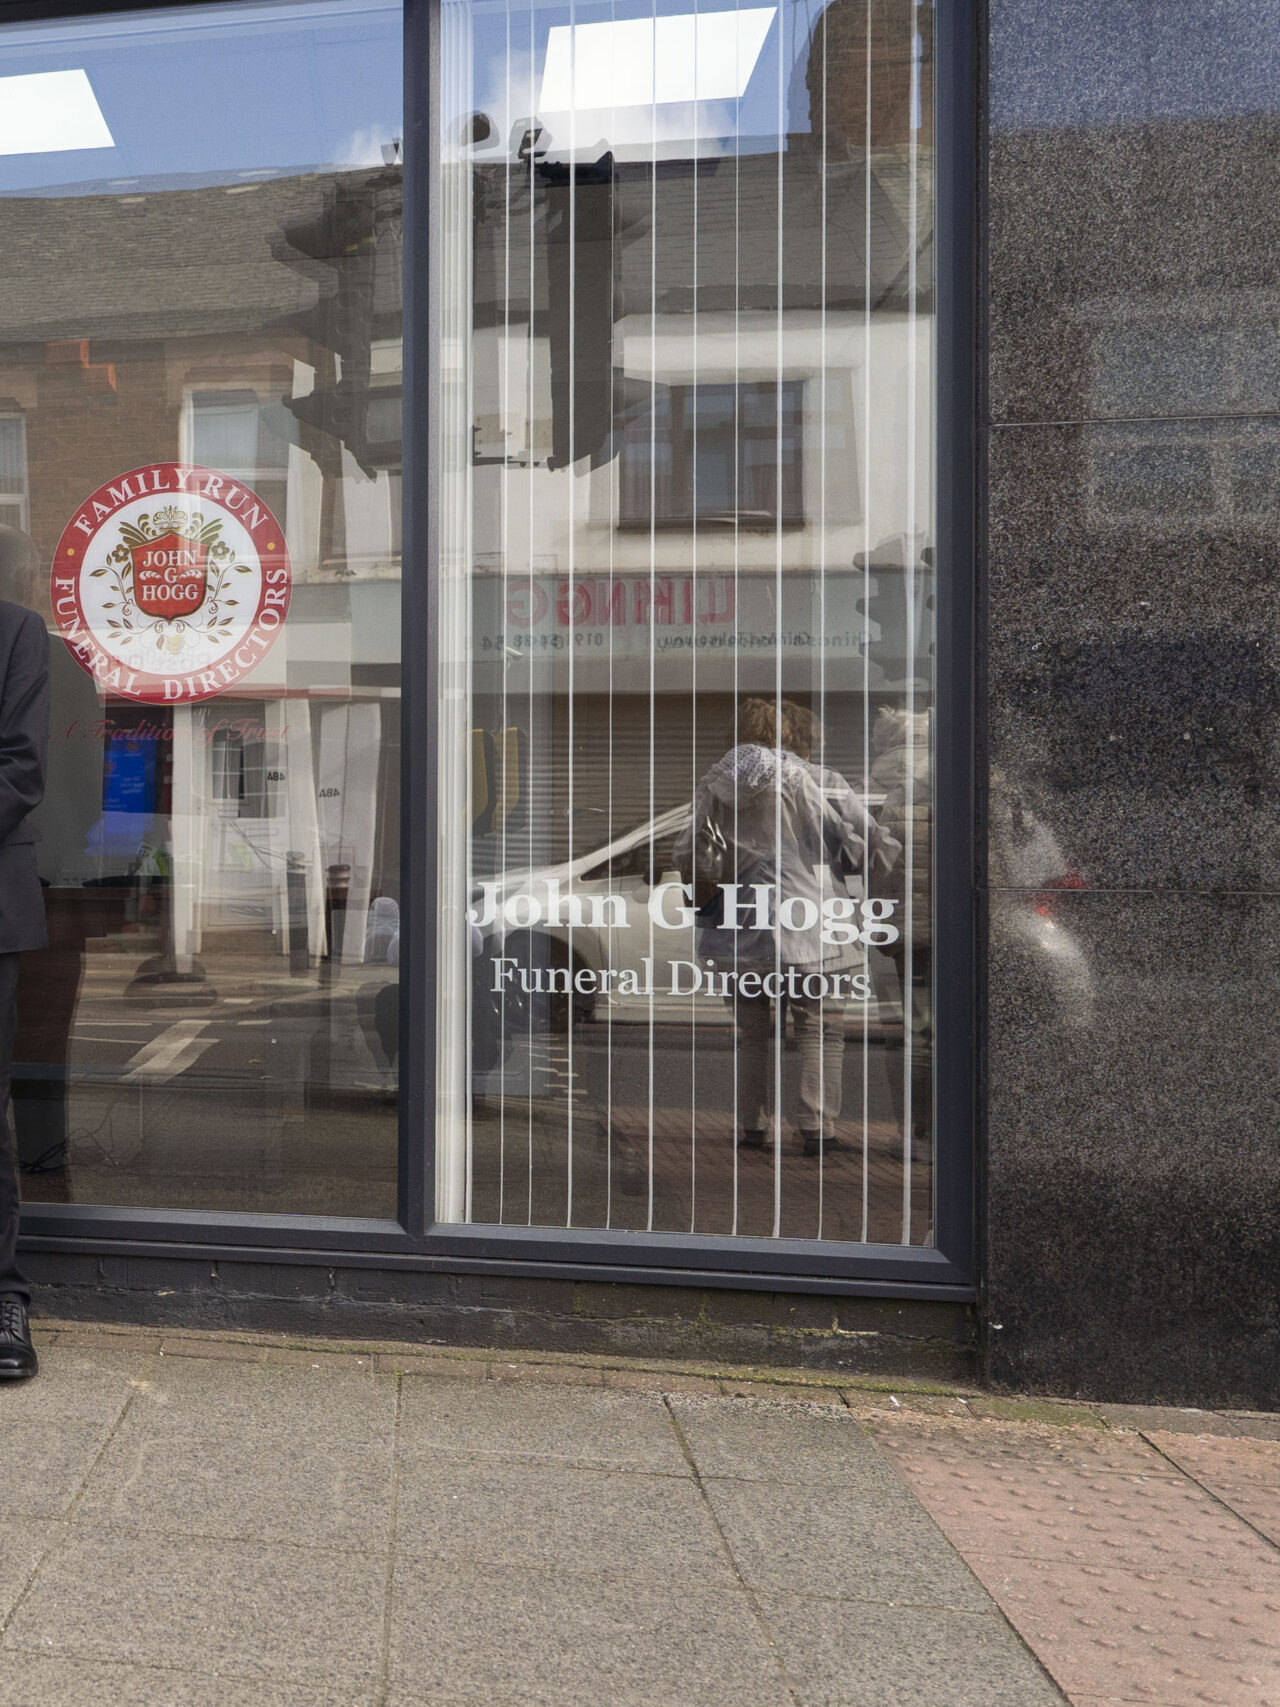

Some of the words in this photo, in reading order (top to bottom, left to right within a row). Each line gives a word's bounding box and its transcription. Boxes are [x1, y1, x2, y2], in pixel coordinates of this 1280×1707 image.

[73, 468, 194, 537] FAMILY
[203, 473, 269, 531] RUN
[142, 550, 198, 567] JOHN
[164, 567, 179, 583] G
[142, 583, 199, 602] HOGG
[55, 576, 141, 697] FUNERAL
[163, 568, 288, 700] DIRECTORS
[83, 719, 190, 741] Tradition
[193, 717, 228, 747] of
[226, 718, 291, 740] Trust
[465, 878, 631, 928] John
[648, 882, 701, 930] G
[716, 883, 900, 946] Hogg
[490, 957, 656, 996] Funeral
[666, 959, 871, 1001] Directors
